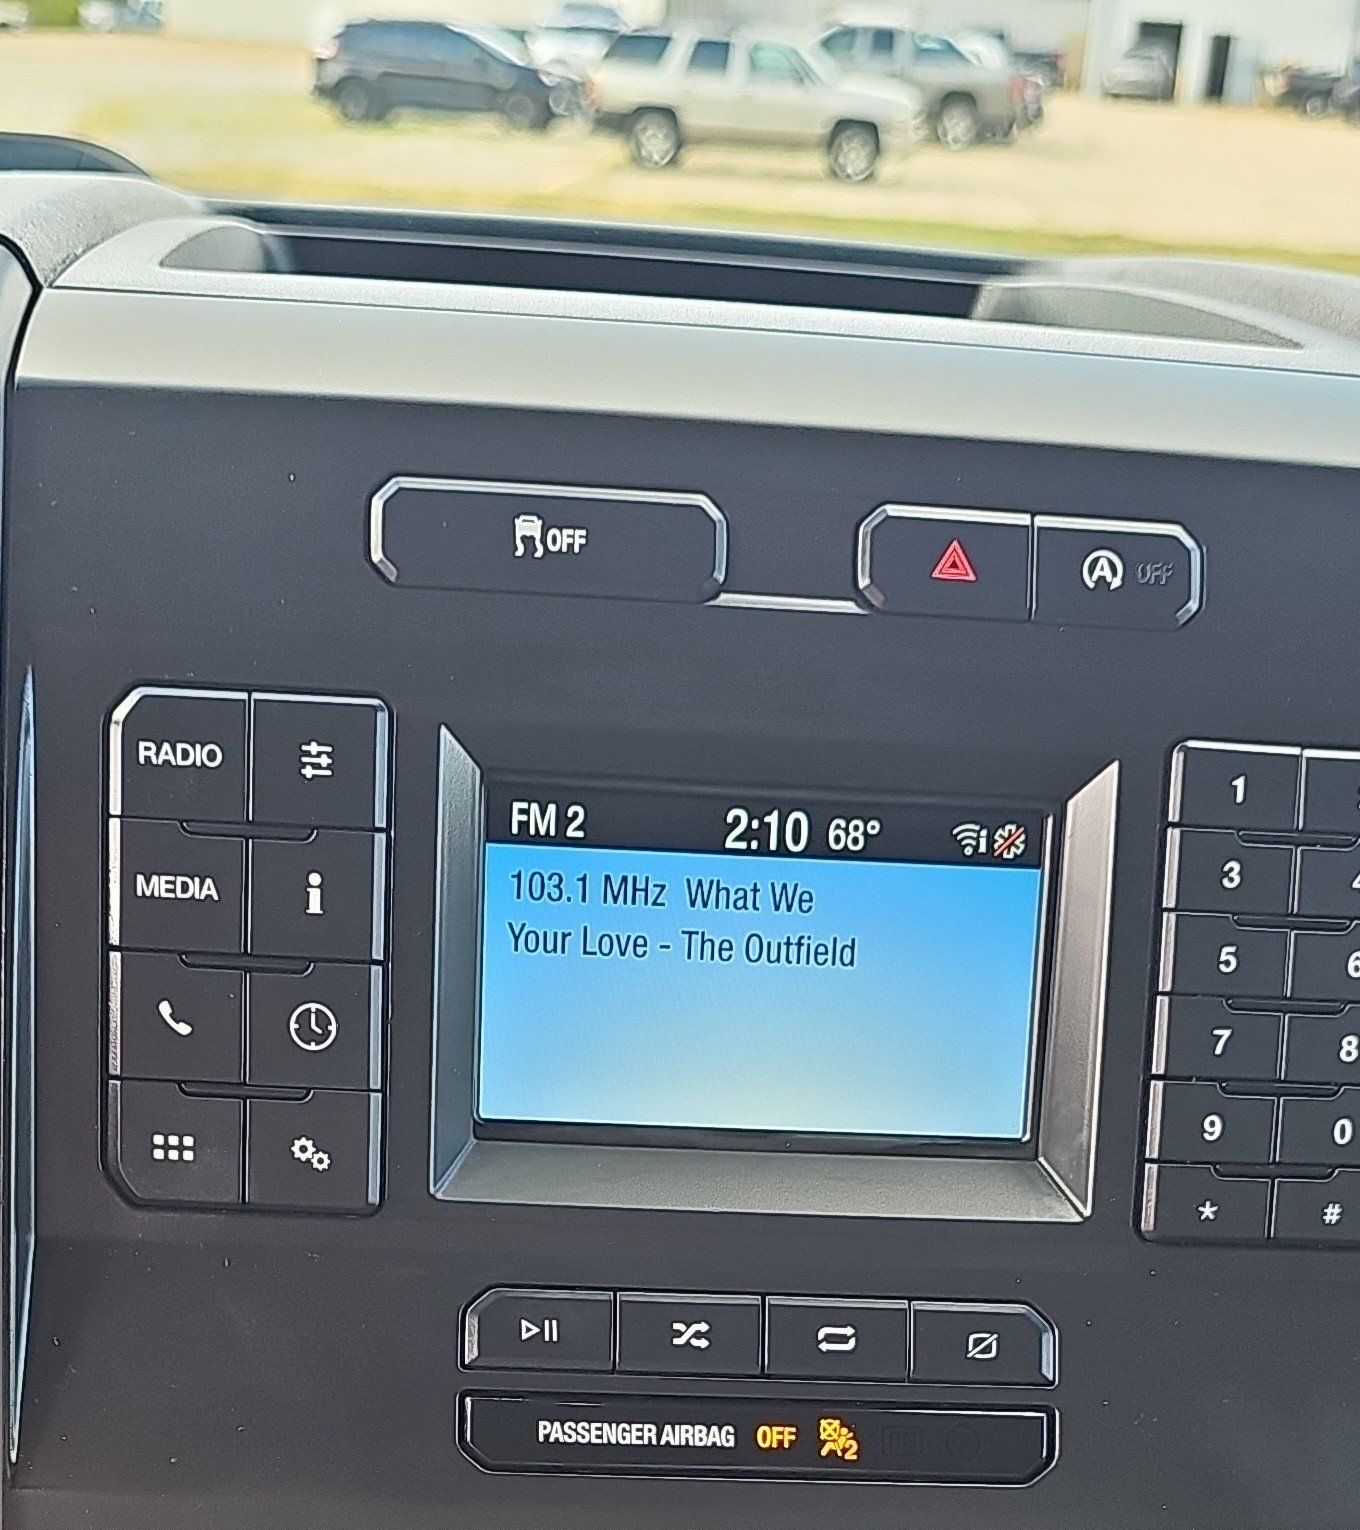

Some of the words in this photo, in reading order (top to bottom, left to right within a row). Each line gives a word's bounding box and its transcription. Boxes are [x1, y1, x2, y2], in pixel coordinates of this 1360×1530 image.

[546, 527, 588, 555] OFF
[1137, 562, 1174, 585] OFF
[139, 741, 223, 769] RADIO
[1230, 775, 1247, 804] 1
[511, 802, 556, 837] FM
[565, 806, 586, 838] 2
[724, 807, 810, 853] 2:10
[827, 818, 882, 852] 68°
[136, 874, 219, 901] MEDIA
[1221, 861, 1242, 889] 3
[509, 870, 590, 904] 103.1
[602, 873, 667, 908] MHz
[685, 877, 762, 912] What
[770, 880, 815, 915] We
[507, 921, 571, 957] Your
[581, 925, 649, 960] Love
[681, 929, 733, 964] The
[744, 932, 857, 968] Outfield
[1218, 946, 1239, 974] 5
[1212, 1028, 1233, 1055] 7
[1339, 1035, 1360, 1062] 8
[1202, 1114, 1222, 1142] 9
[1333, 1118, 1353, 1145] 0
[538, 1420, 658, 1446] PASSENGER
[660, 1423, 735, 1448] AIRBAG
[756, 1426, 797, 1449] OFF
